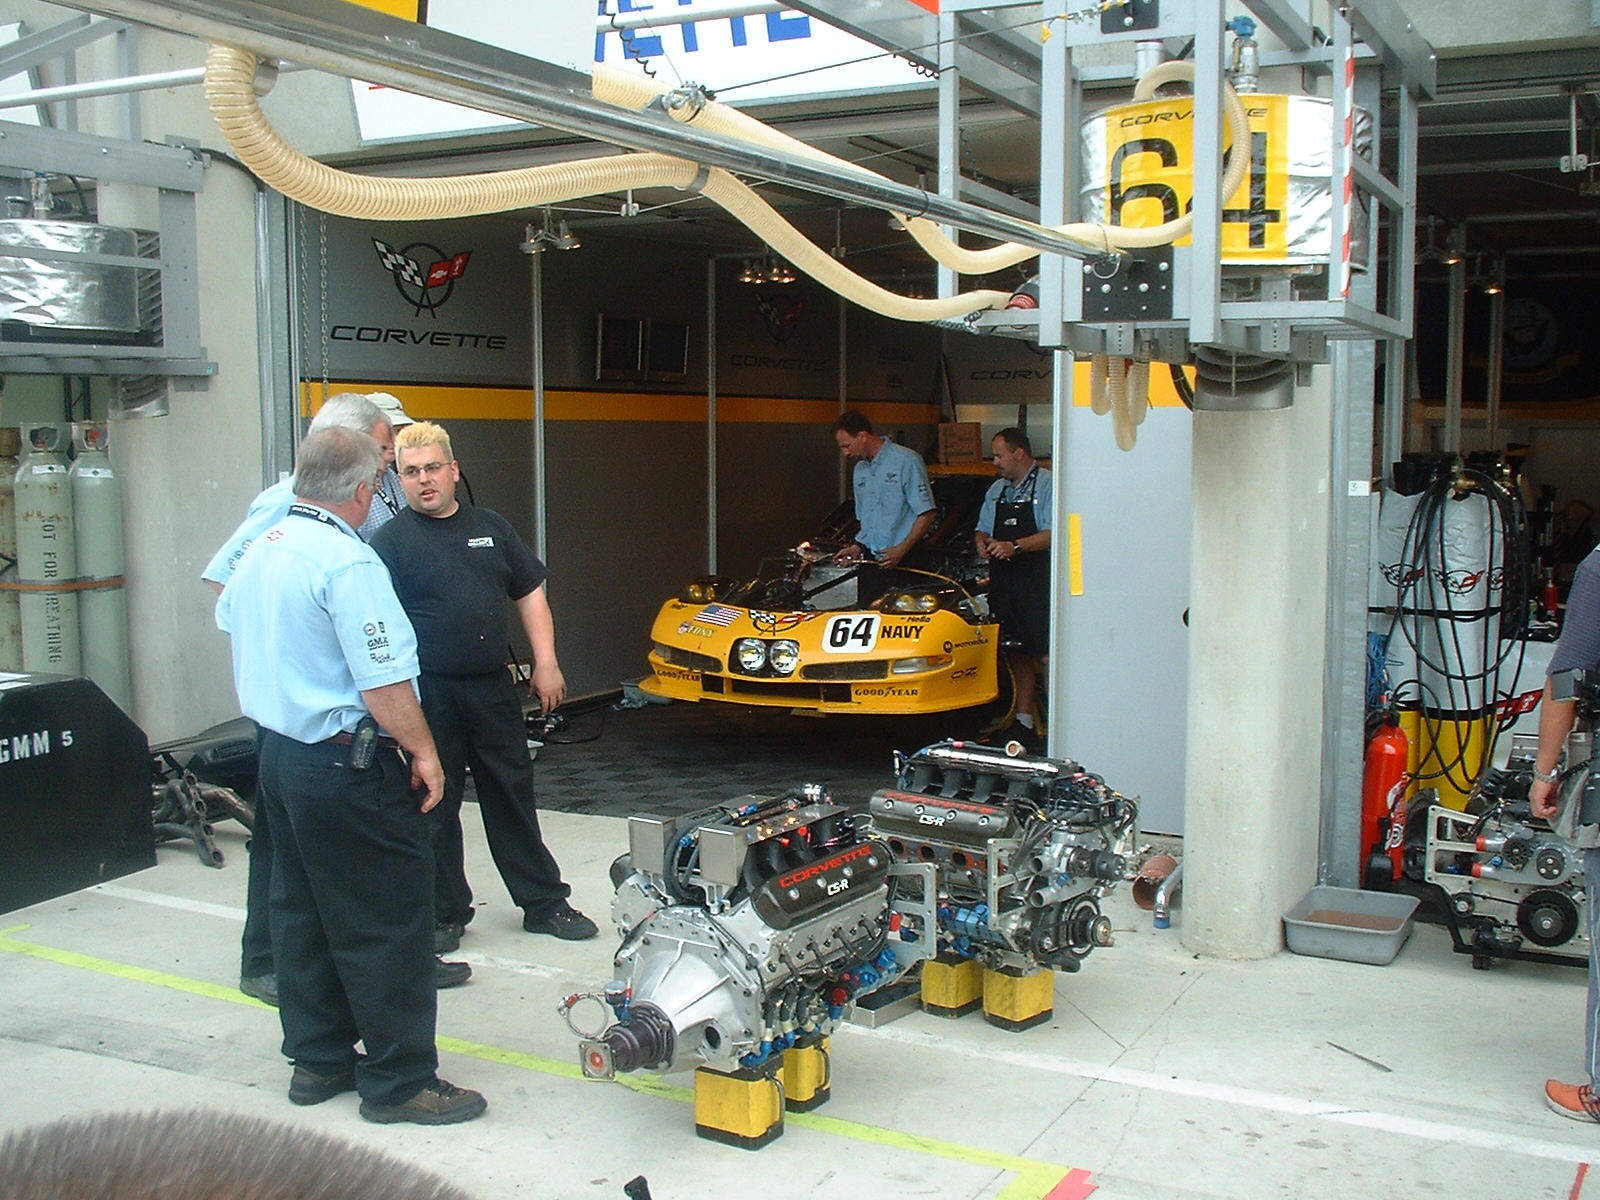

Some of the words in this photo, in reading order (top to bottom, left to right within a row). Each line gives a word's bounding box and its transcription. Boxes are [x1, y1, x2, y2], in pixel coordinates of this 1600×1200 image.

[1110, 131, 1281, 249] 64
[330, 325, 508, 350] CORVETTE
[730, 354, 827, 372] CORVETTE
[43, 551, 58, 578] FOR
[829, 617, 875, 648] 64
[881, 625, 924, 639] NAVY
[61, 730, 73, 747] 5
[779, 845, 872, 888] CORVETTE
